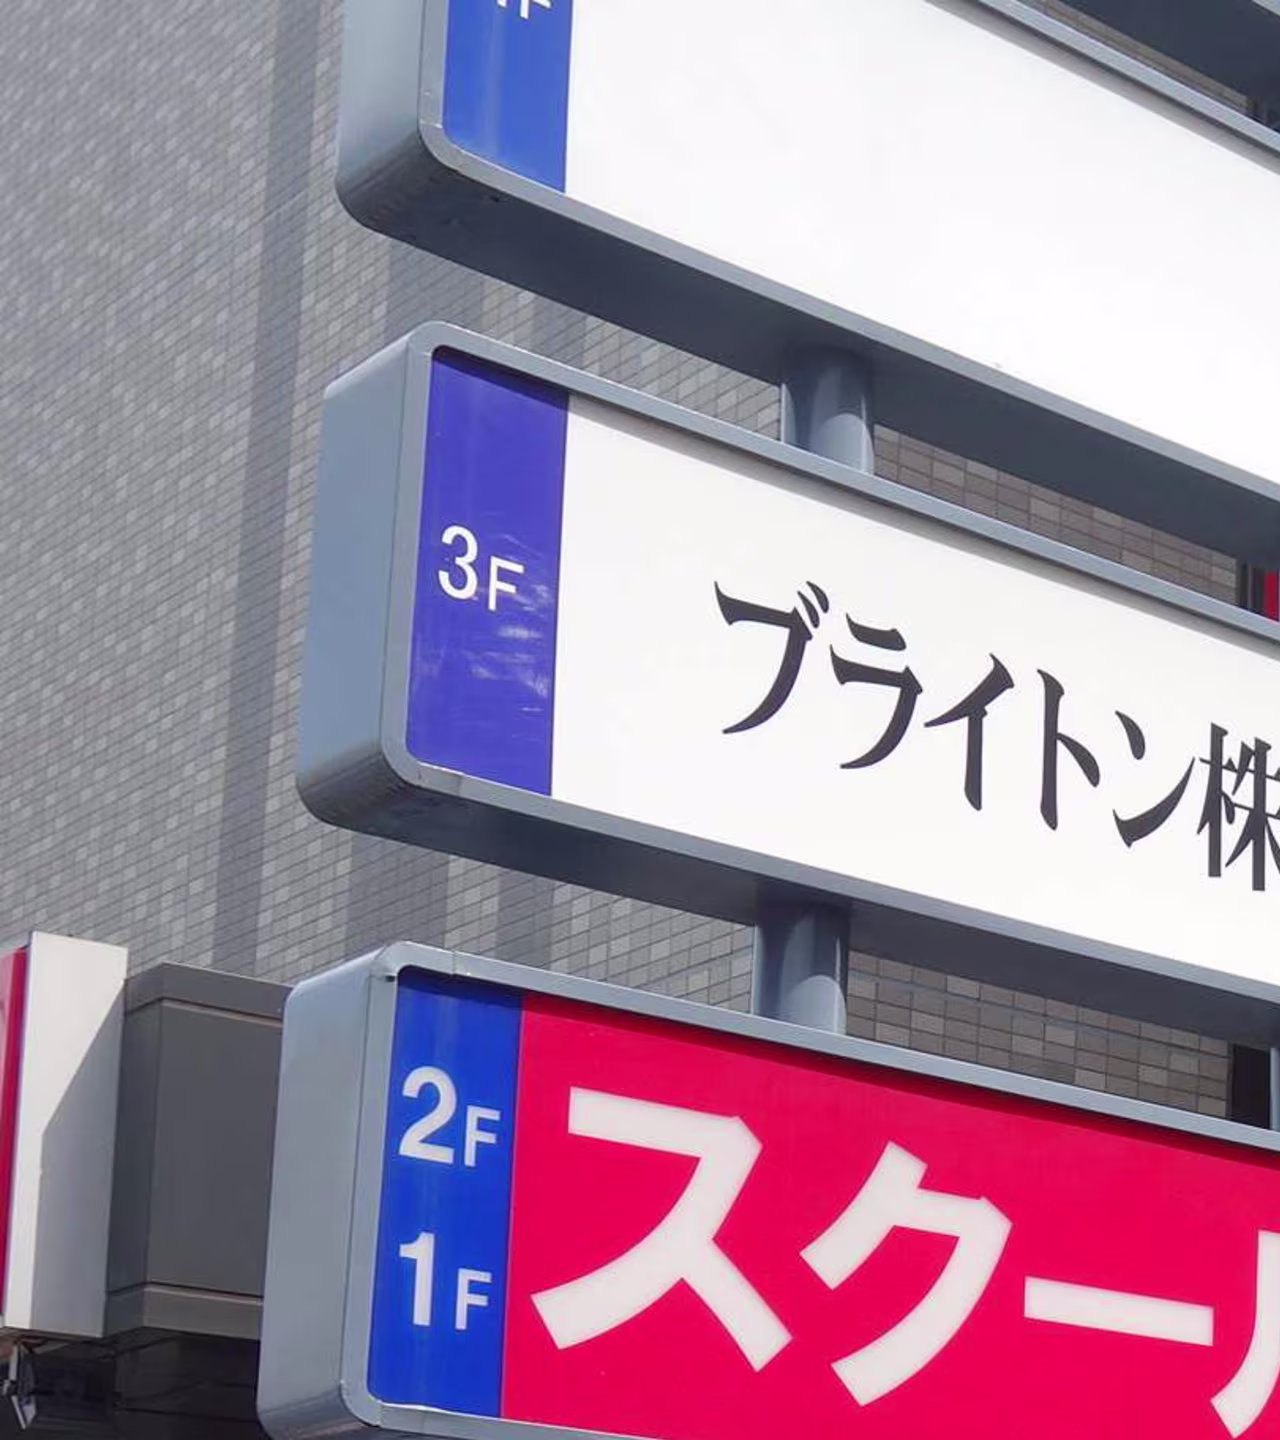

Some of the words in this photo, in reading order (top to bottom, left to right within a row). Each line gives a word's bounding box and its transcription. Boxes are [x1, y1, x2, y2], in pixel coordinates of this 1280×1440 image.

[437, 525, 524, 612] 3F
[398, 1066, 501, 1168] 2F
[398, 1232, 492, 1331] 1F
